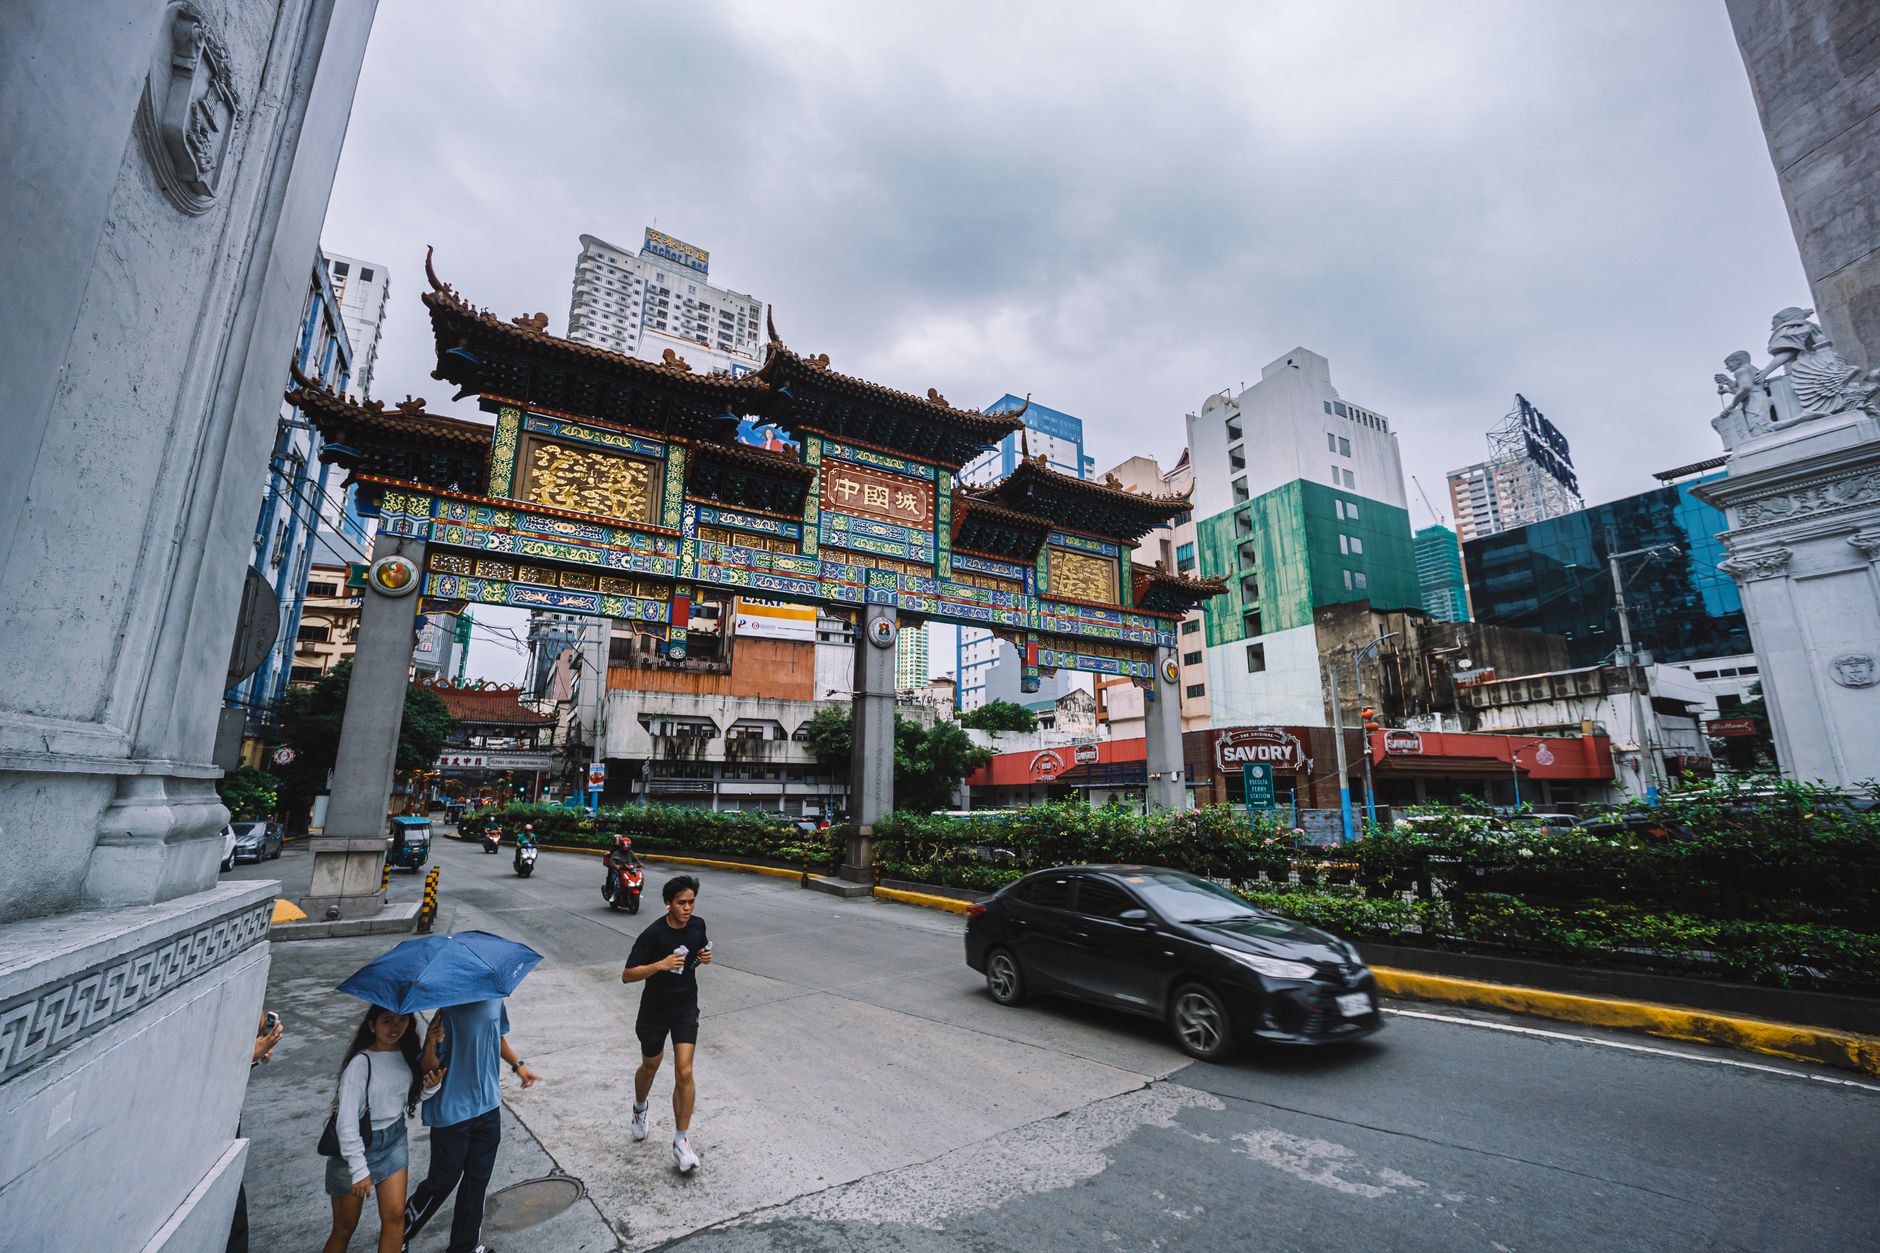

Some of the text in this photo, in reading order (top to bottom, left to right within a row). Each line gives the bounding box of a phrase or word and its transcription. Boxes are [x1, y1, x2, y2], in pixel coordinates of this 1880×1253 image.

[644, 239, 709, 274] Anchor Land
[833, 478, 920, 515] 中國城
[1223, 745, 1293, 762] SAVORY
